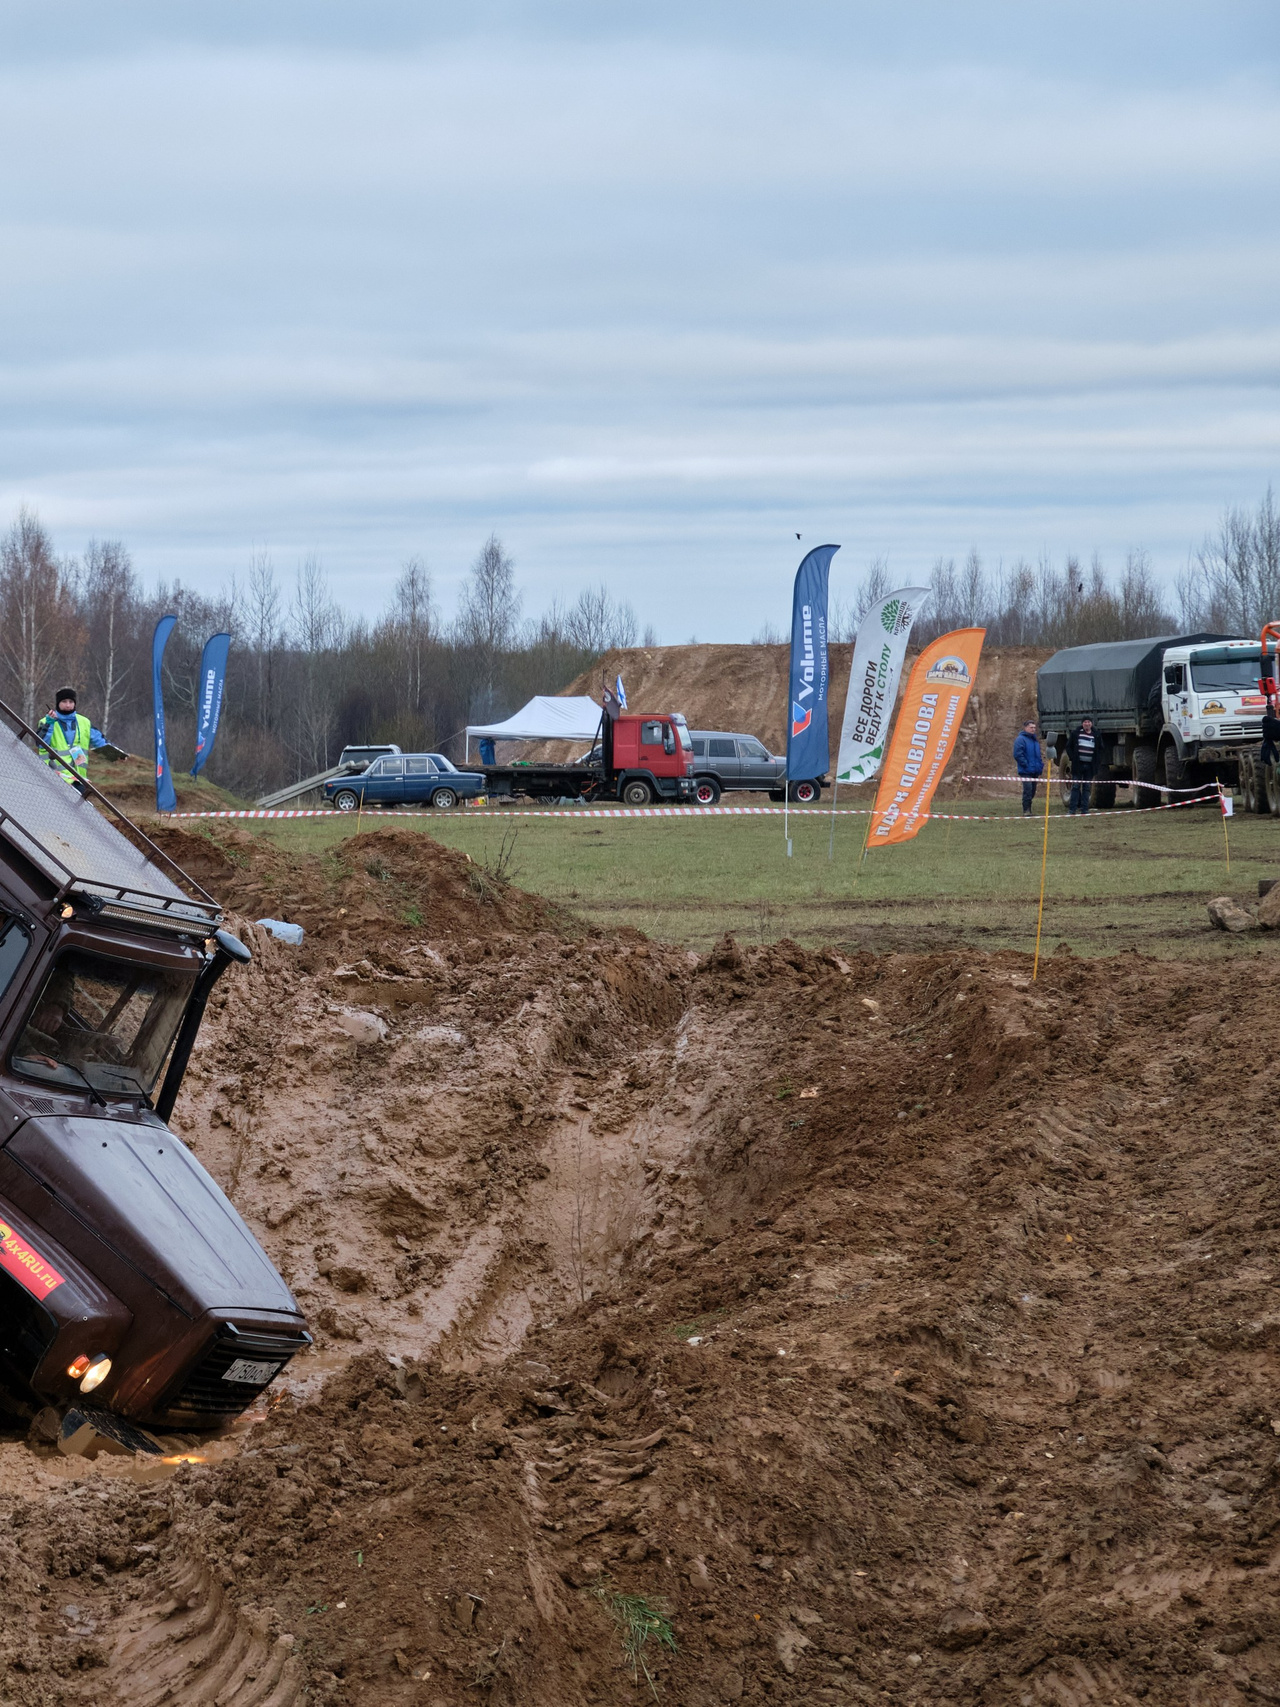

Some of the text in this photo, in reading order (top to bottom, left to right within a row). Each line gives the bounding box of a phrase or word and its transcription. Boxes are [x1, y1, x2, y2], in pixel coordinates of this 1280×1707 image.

[799, 605, 813, 701] Volume
[818, 650, 827, 701] МОТОРНЫЕ
[853, 661, 878, 743] ВСЕ ДОРОГИ
[865, 644, 892, 746] ВЕДУТ К СТОЛУ
[936, 739, 948, 760] БЕЗ
[943, 694, 960, 738] ГРАНИЦ
[875, 693, 939, 836] ПАРК ПАВЛОВА
[4, 1238, 57, 1289] 4x4RU.ru
